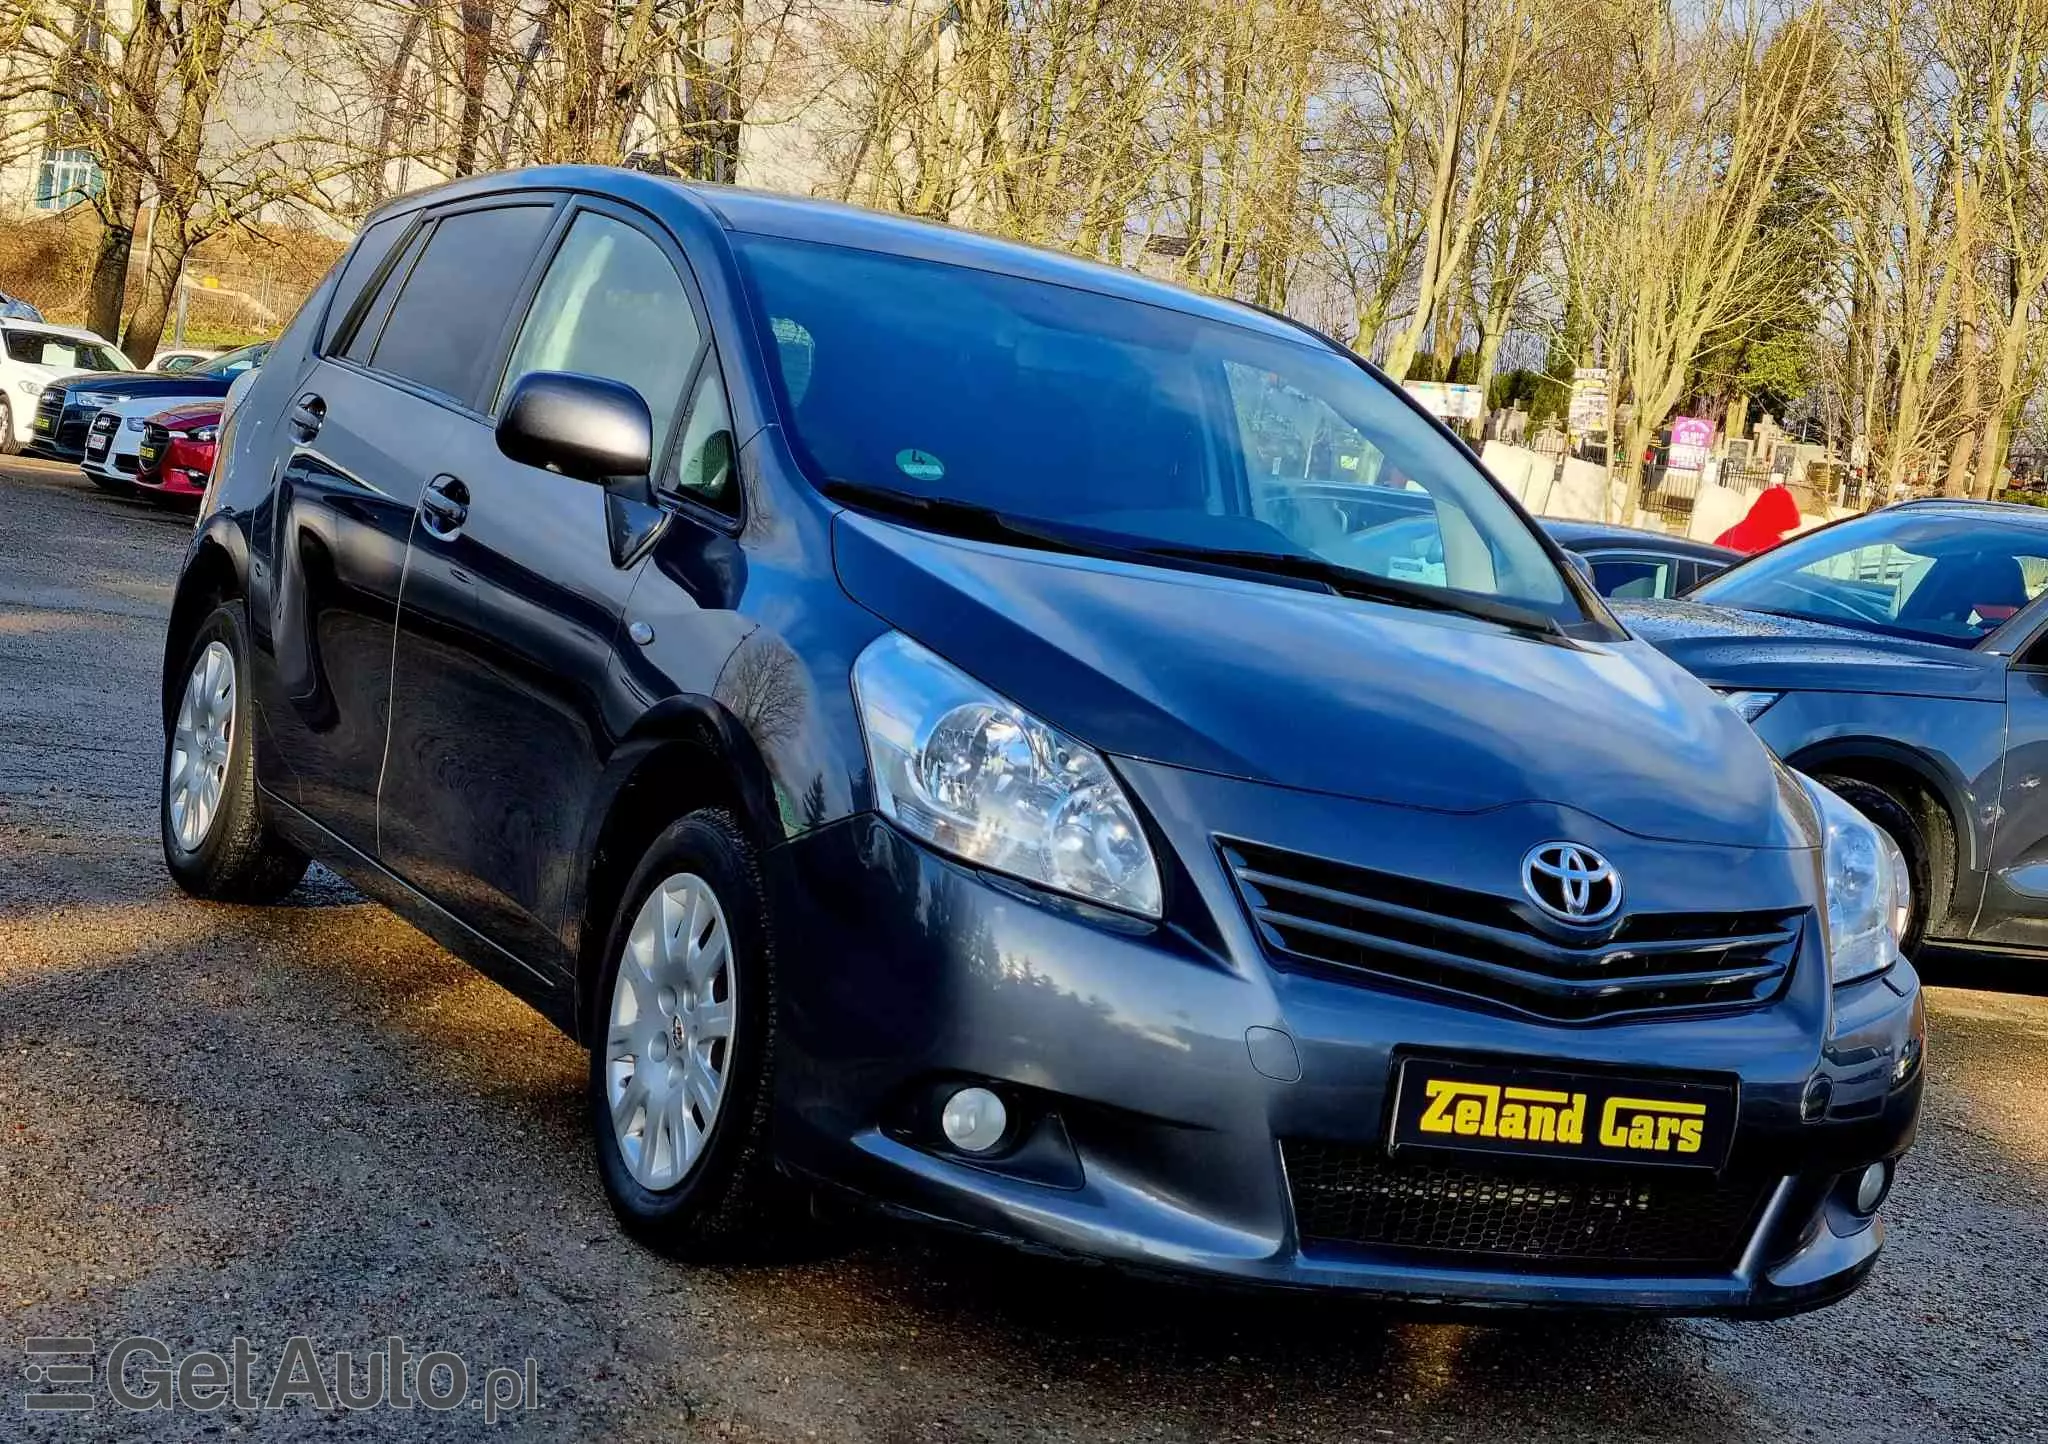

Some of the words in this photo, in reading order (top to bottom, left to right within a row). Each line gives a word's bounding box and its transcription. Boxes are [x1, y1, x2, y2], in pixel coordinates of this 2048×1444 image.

[911, 449, 926, 465] 4
[1419, 1079, 1587, 1145] Zeland
[1598, 1096, 1707, 1153] Cars
